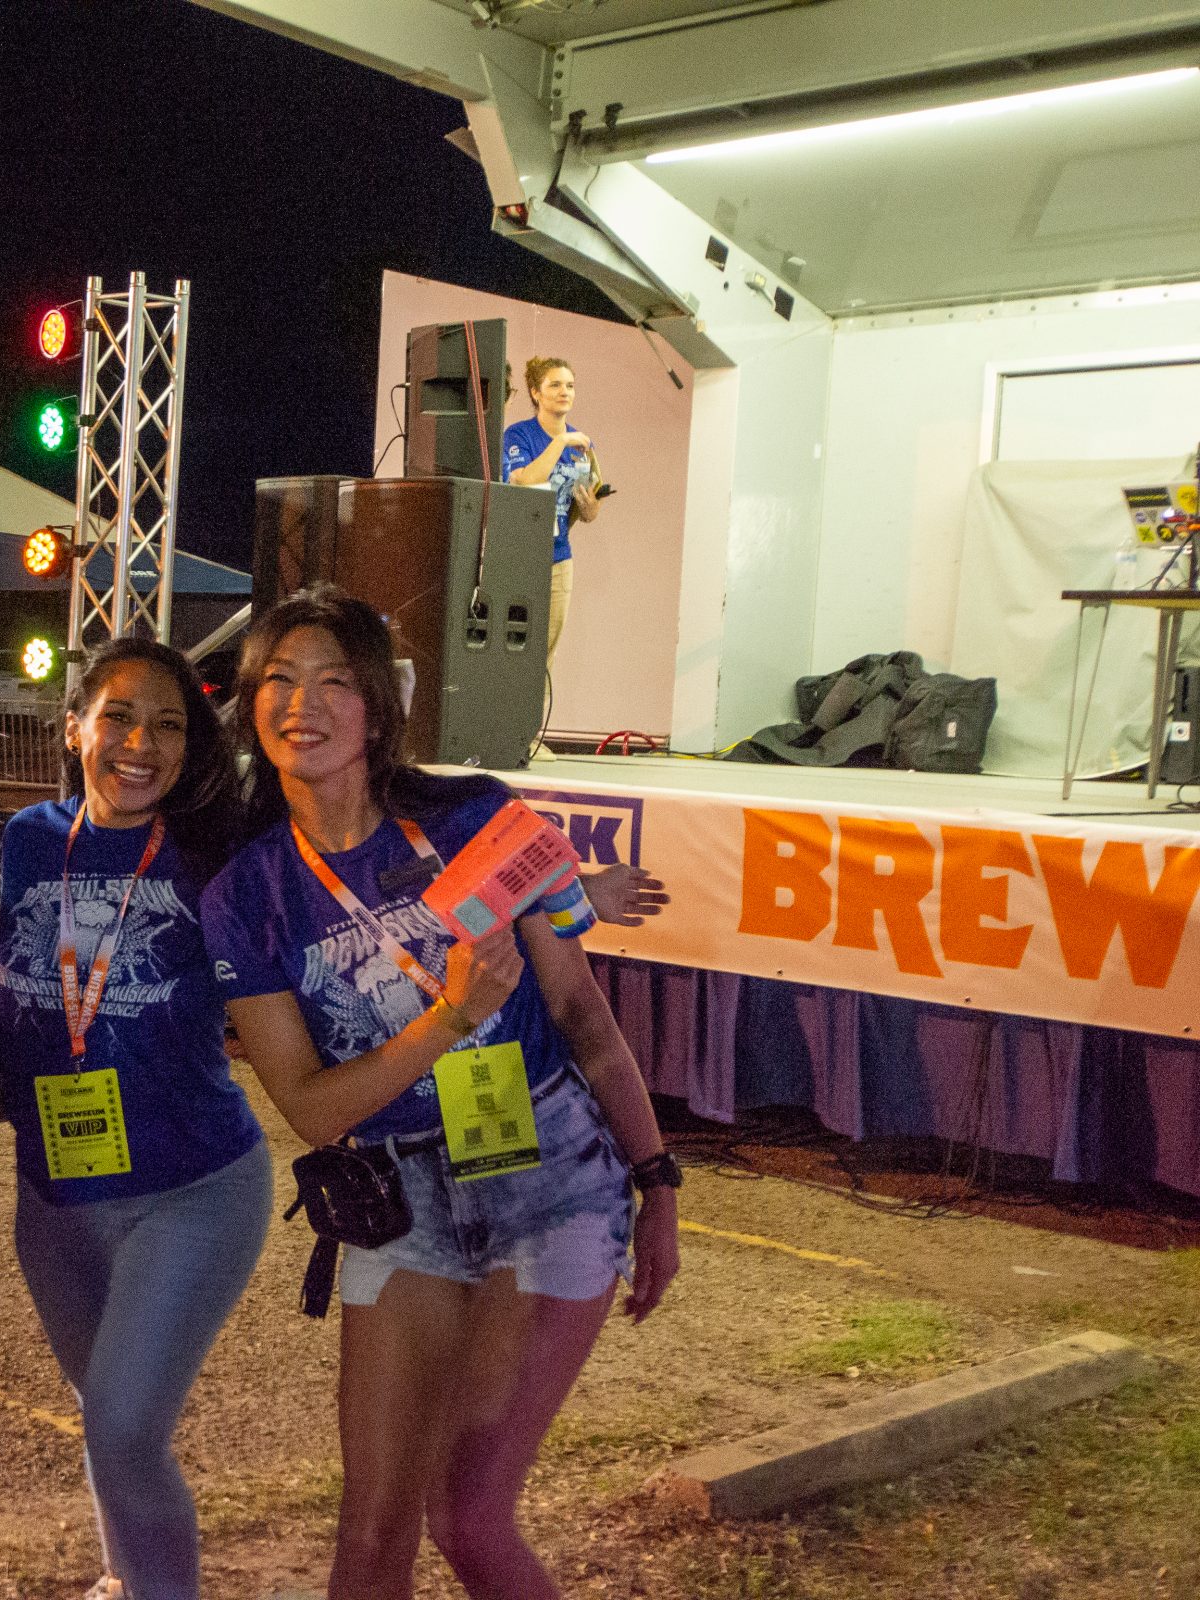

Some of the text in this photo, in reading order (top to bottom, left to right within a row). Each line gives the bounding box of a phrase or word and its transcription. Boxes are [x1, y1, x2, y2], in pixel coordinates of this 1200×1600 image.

[371, 896, 413, 916] NNUAL
[738, 807, 1200, 989] BREW
[57, 1108, 106, 1120] BREWSEUM
[64, 1119, 103, 1137] VIP
